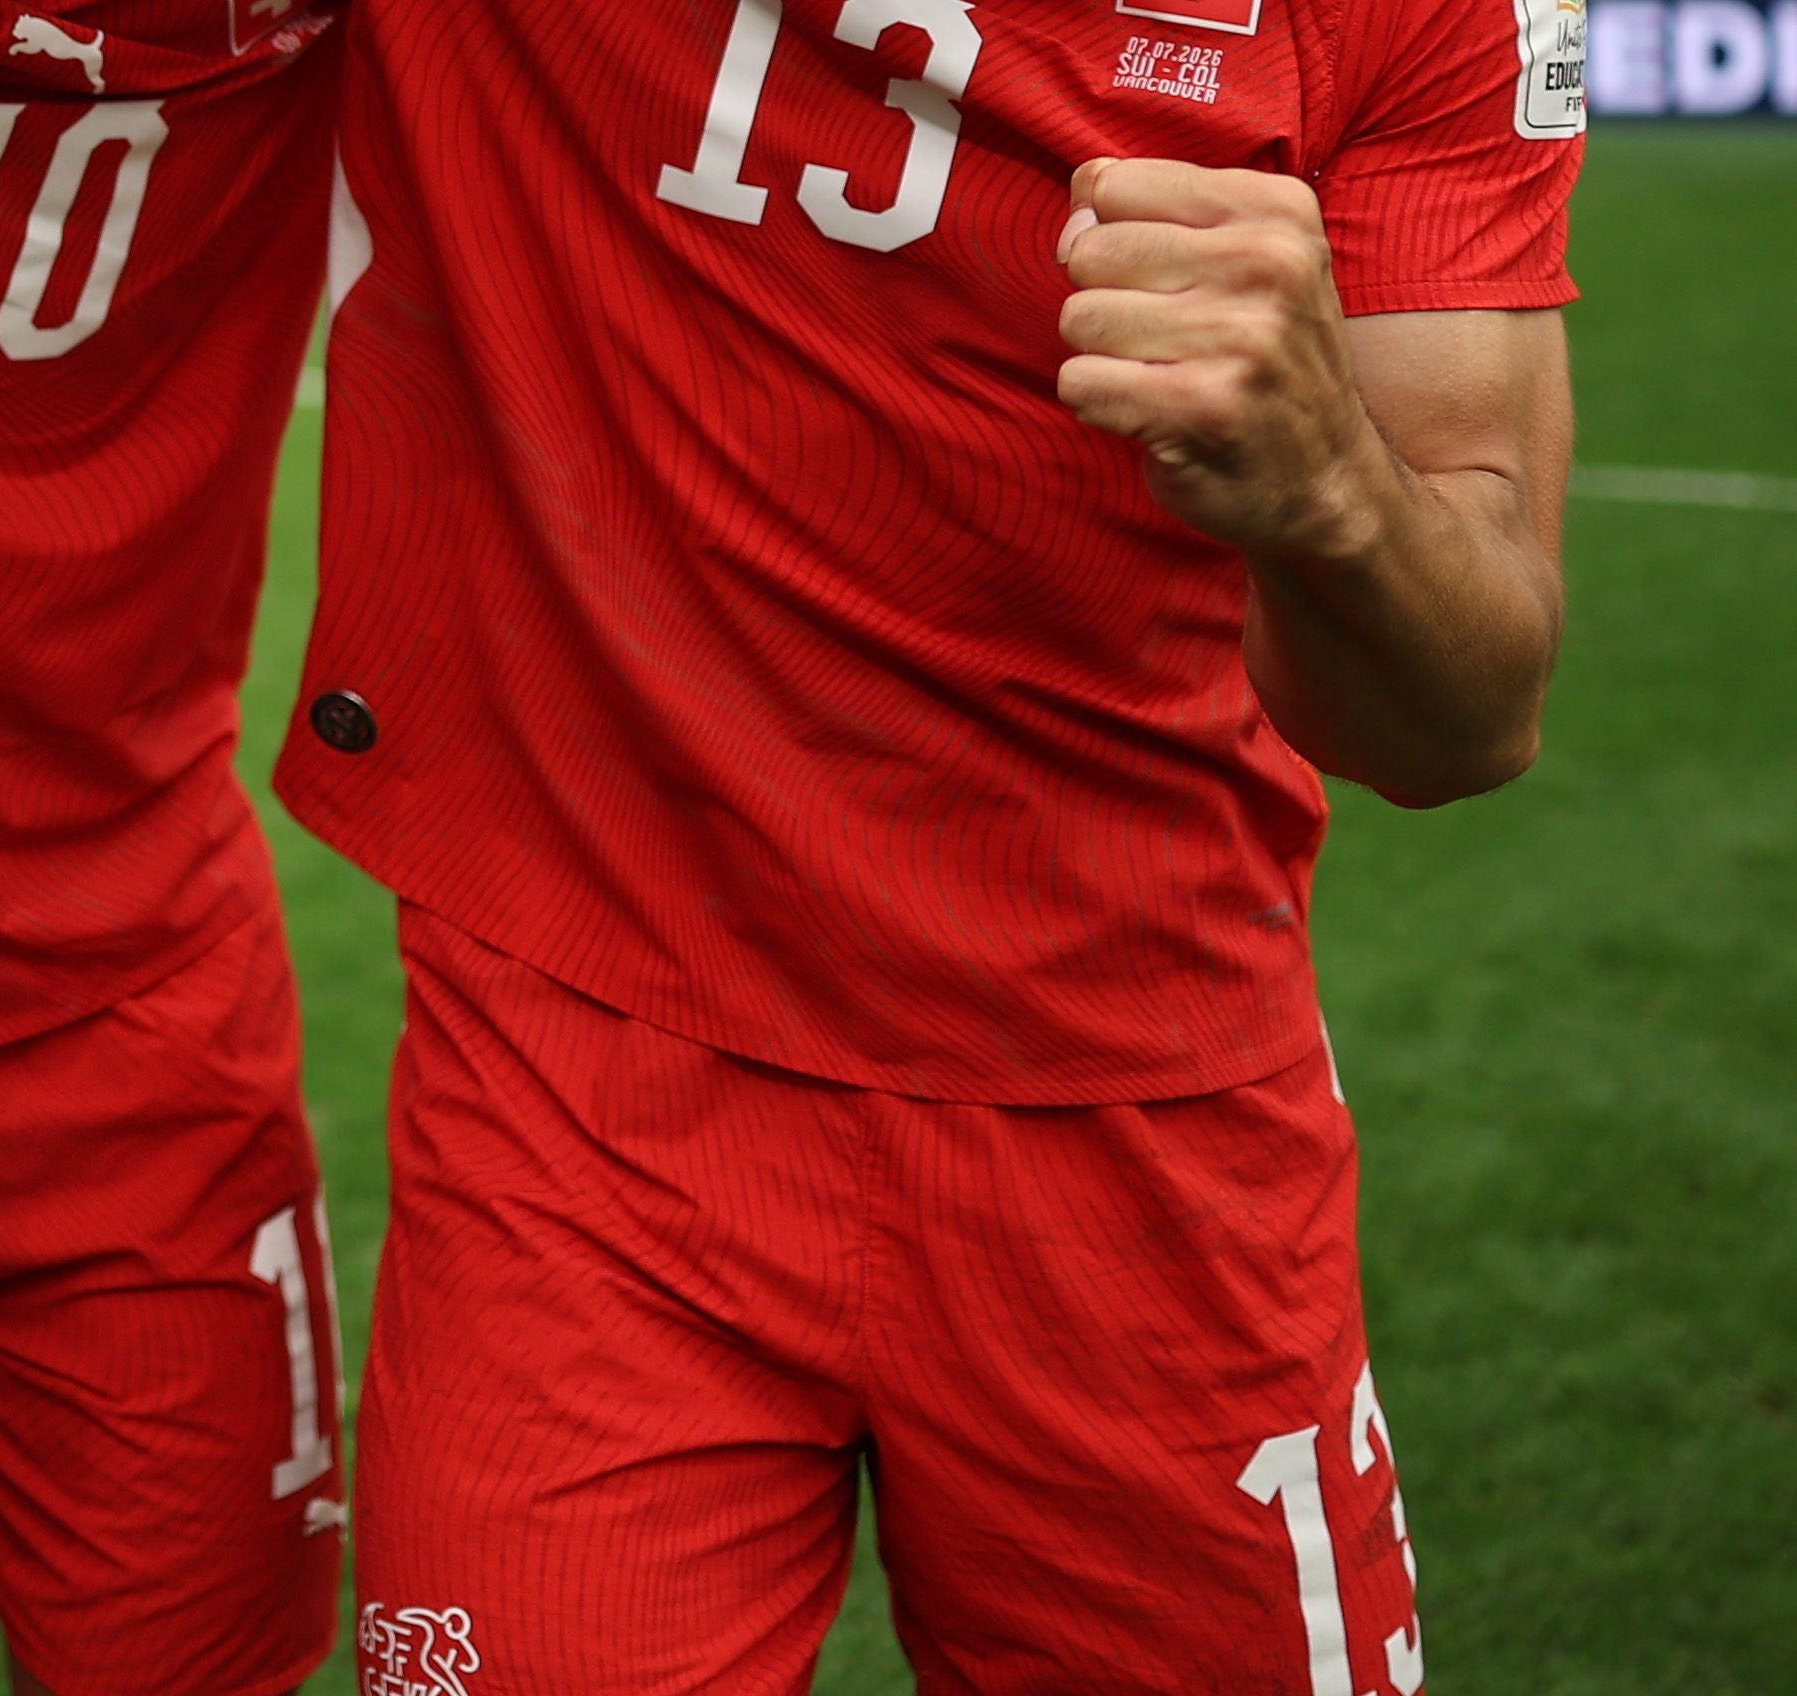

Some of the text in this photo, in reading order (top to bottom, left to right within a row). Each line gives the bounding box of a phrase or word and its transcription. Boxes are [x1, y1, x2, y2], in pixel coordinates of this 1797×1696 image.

[1125, 36, 1224, 66] 07.07.2026
[1116, 52, 1156, 78] SUI
[1177, 63, 1221, 89] COL
[1112, 74, 1217, 105] VANCOUVER
